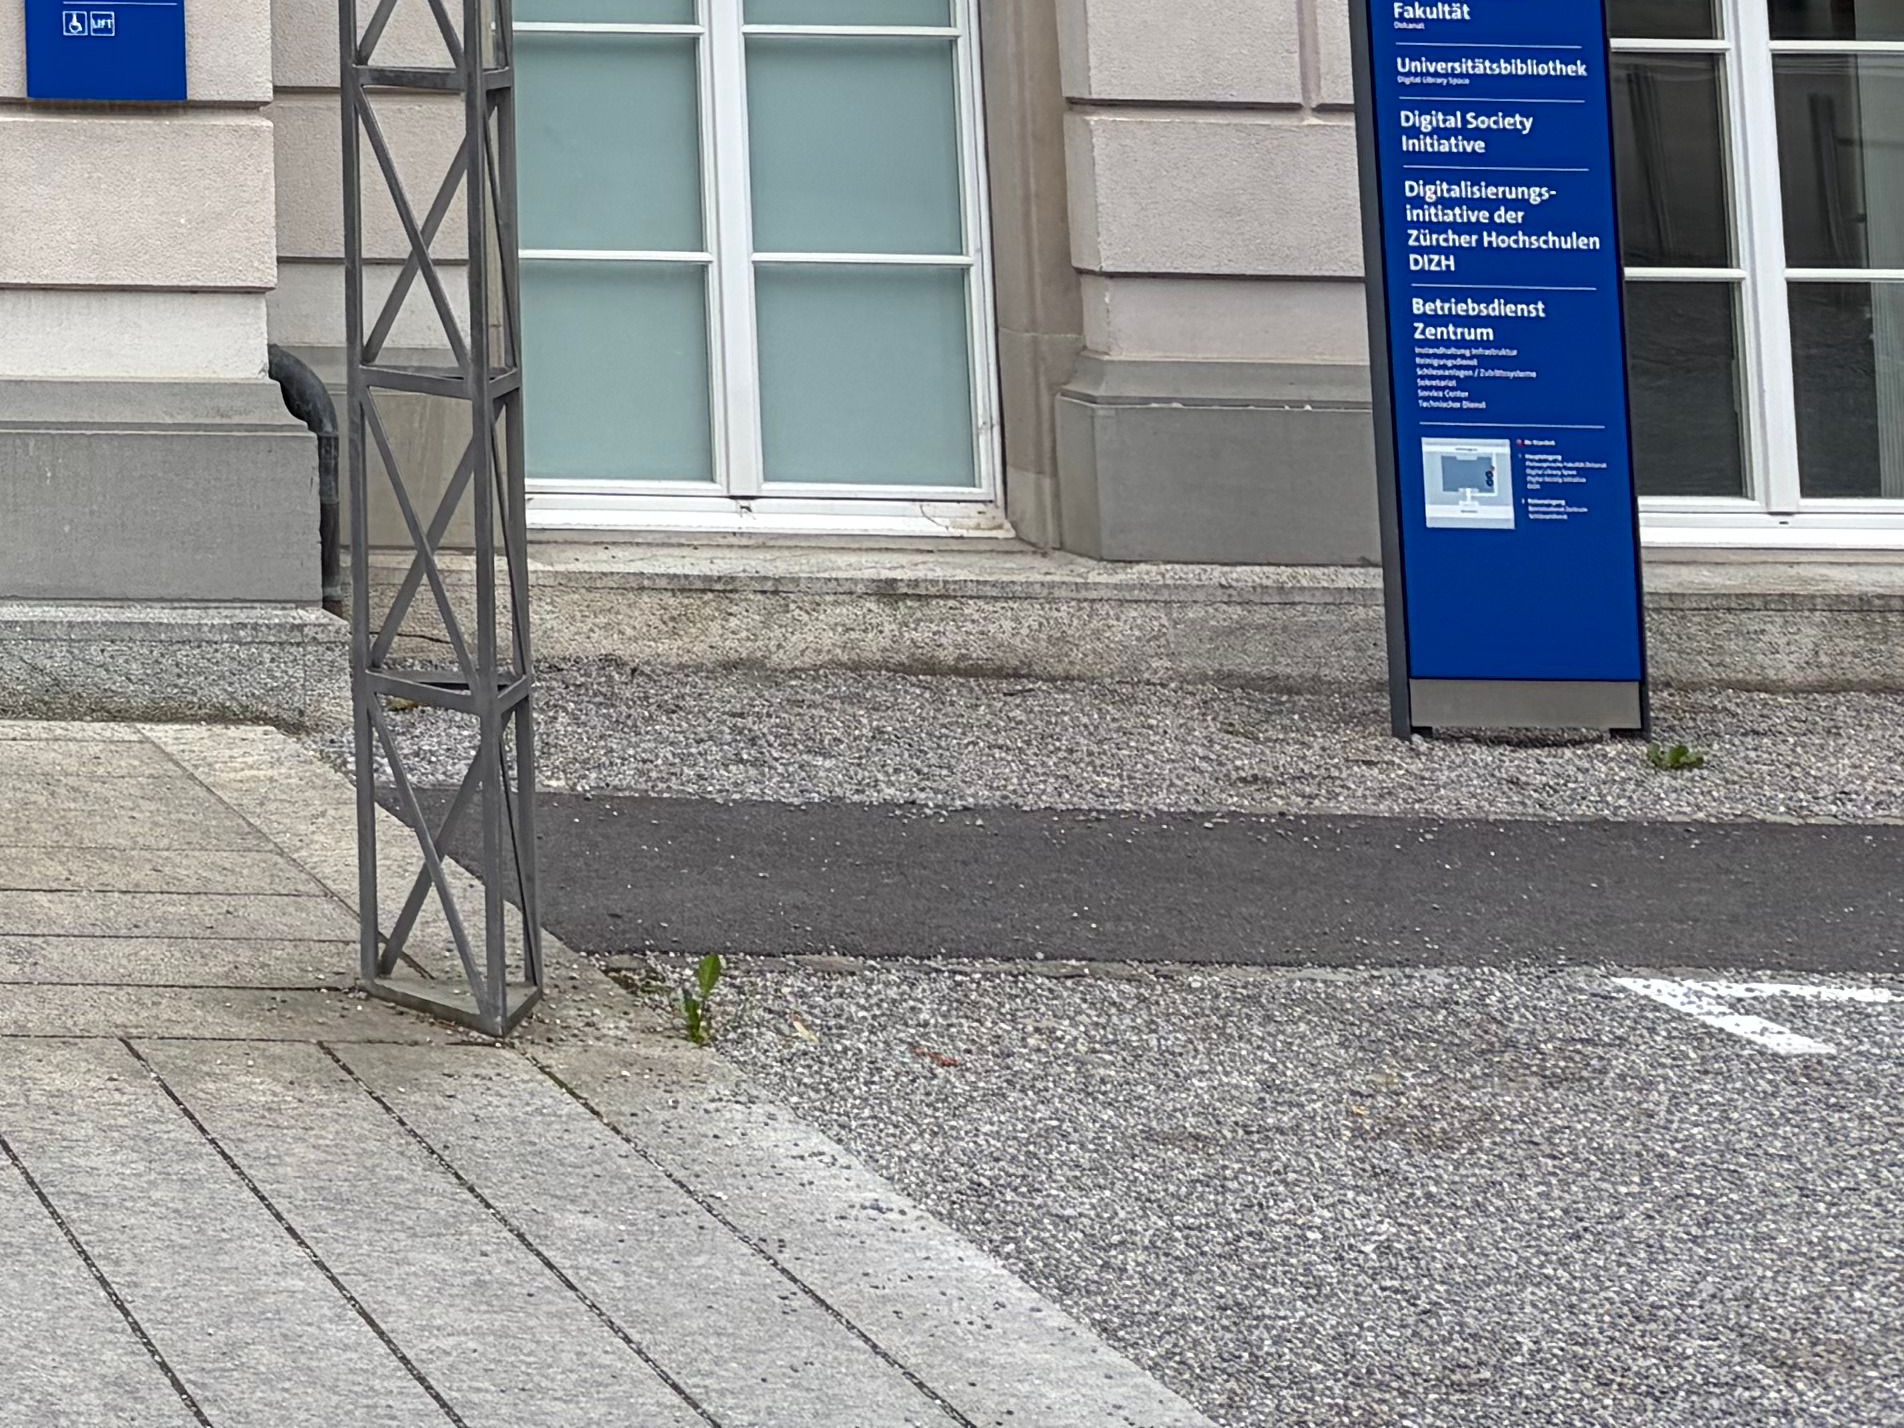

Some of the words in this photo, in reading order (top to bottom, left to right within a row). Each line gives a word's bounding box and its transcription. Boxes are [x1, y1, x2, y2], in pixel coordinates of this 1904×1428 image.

[1393, 1, 1471, 20] Fakultät
[92, 19, 113, 29] LIFT
[1396, 57, 1588, 76] Universitätsbibliothek
[1400, 110, 1462, 133] Digital
[1466, 112, 1534, 134] Society
[1402, 135, 1486, 153] Initiative
[1405, 180, 1557, 204] Digitalisierungs-
[1406, 204, 1490, 223] initiative
[1493, 205, 1525, 224] der
[1407, 229, 1478, 247] Zürcher
[1483, 230, 1601, 249] Hochschulen
[1409, 253, 1456, 271] DIZH
[1412, 297, 1546, 317] Betriebsdienst
[1413, 322, 1494, 340] Zentrum
